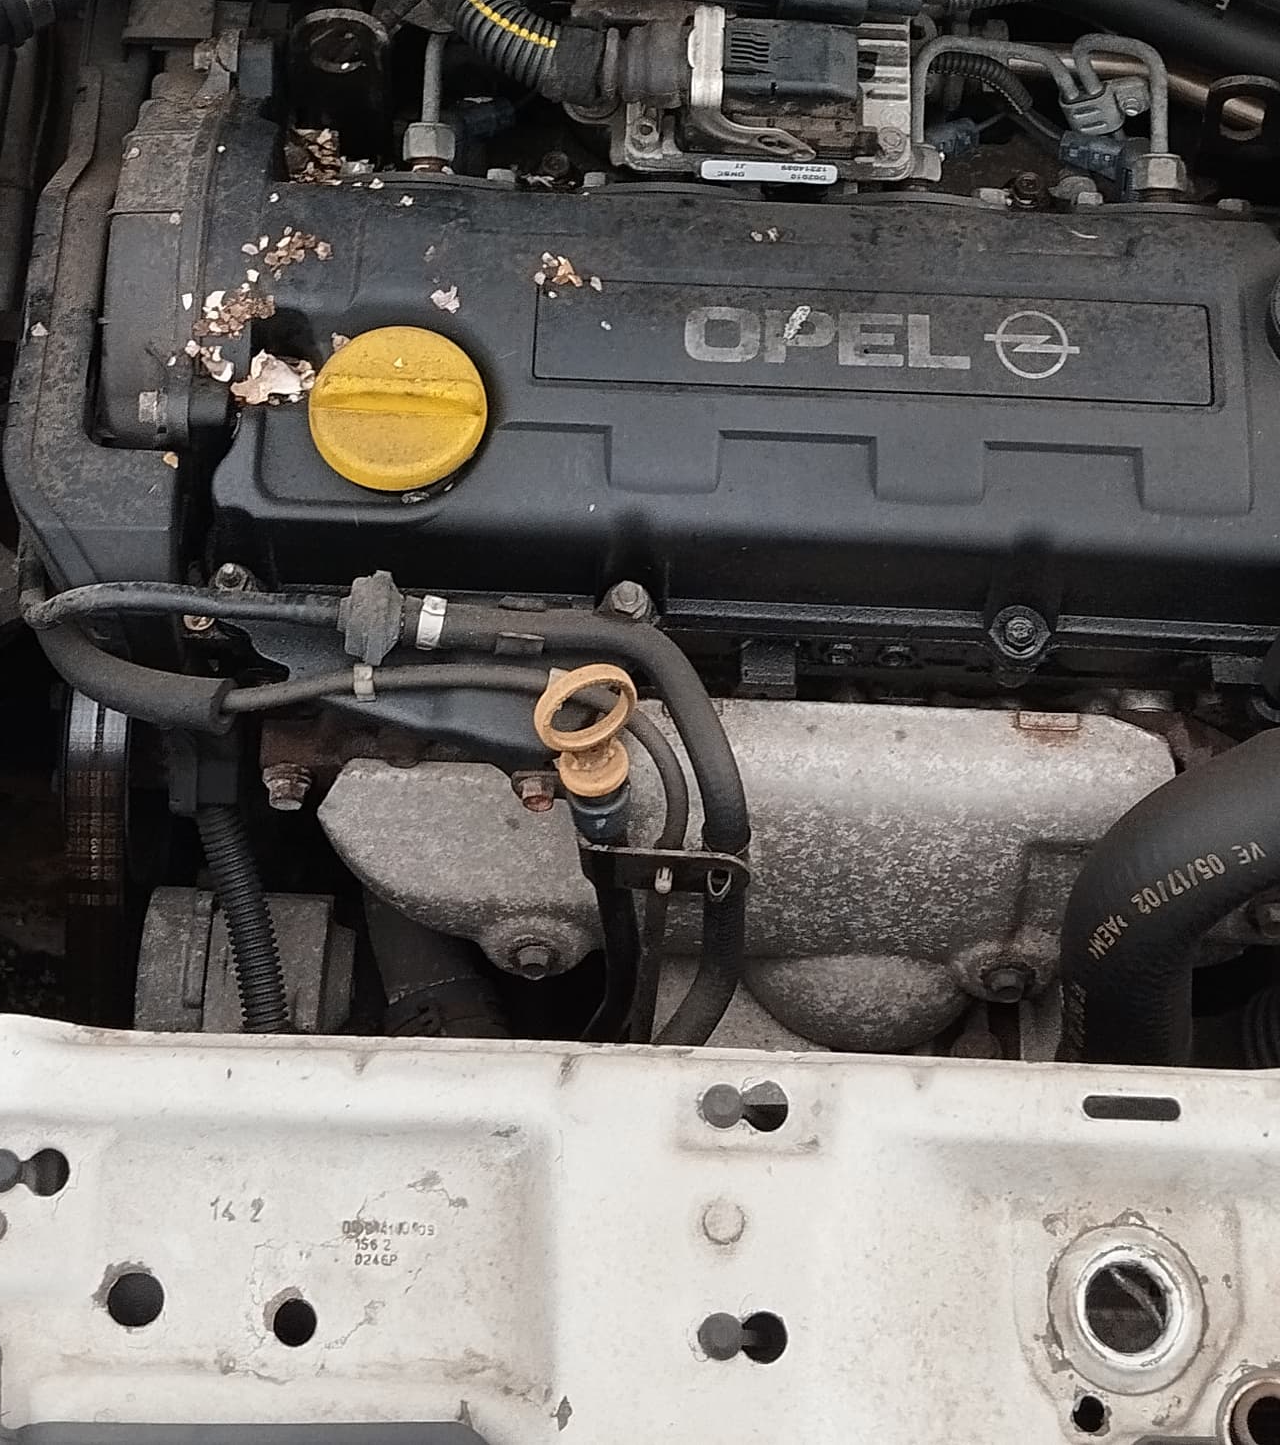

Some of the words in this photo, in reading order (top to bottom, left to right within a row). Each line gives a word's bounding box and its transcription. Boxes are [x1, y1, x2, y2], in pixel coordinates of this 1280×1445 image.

[684, 305, 971, 370] OPEL
[1130, 853, 1227, 915] 05/17/02
[1231, 841, 1267, 865] VE
